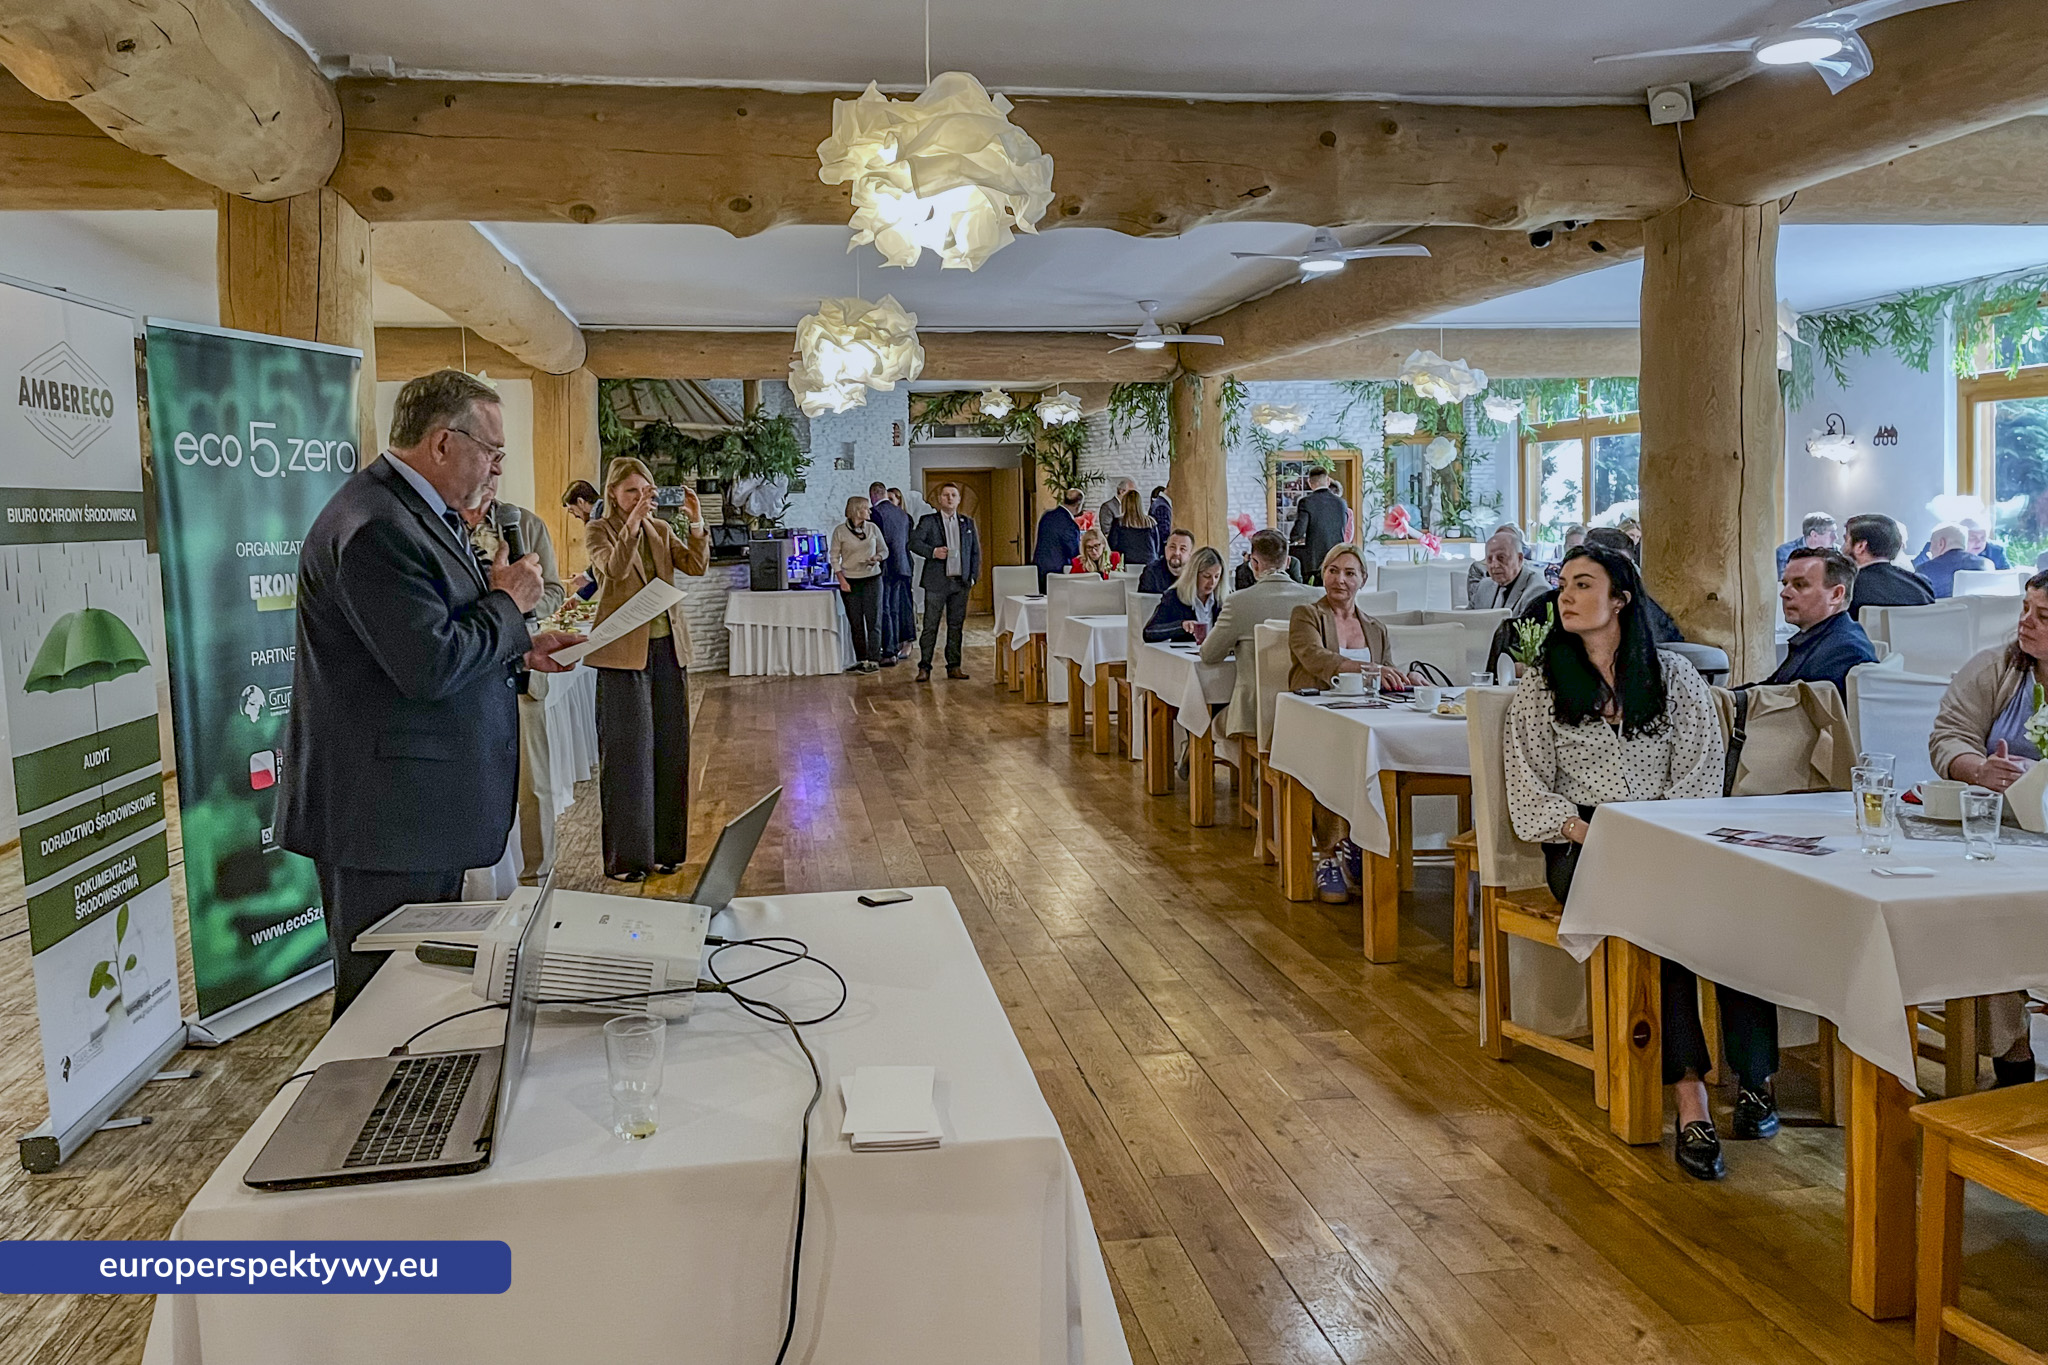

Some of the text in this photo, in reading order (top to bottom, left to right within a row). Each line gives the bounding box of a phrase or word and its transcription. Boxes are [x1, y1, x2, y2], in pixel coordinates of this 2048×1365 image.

[18, 376, 114, 419] AMBERECO
[7, 504, 137, 523] BIURO OCHRONY ŚRODOWISKA
[236, 540, 304, 557] ORGANIZAT
[251, 646, 296, 666] PARTNE
[83, 747, 110, 769] AUDYT
[40, 792, 157, 856] DORADZTWO ŚRODOWISKOWE
[74, 855, 138, 900] DOKUMENTACJA
[75, 873, 140, 920] ŚRODOWISKOWA
